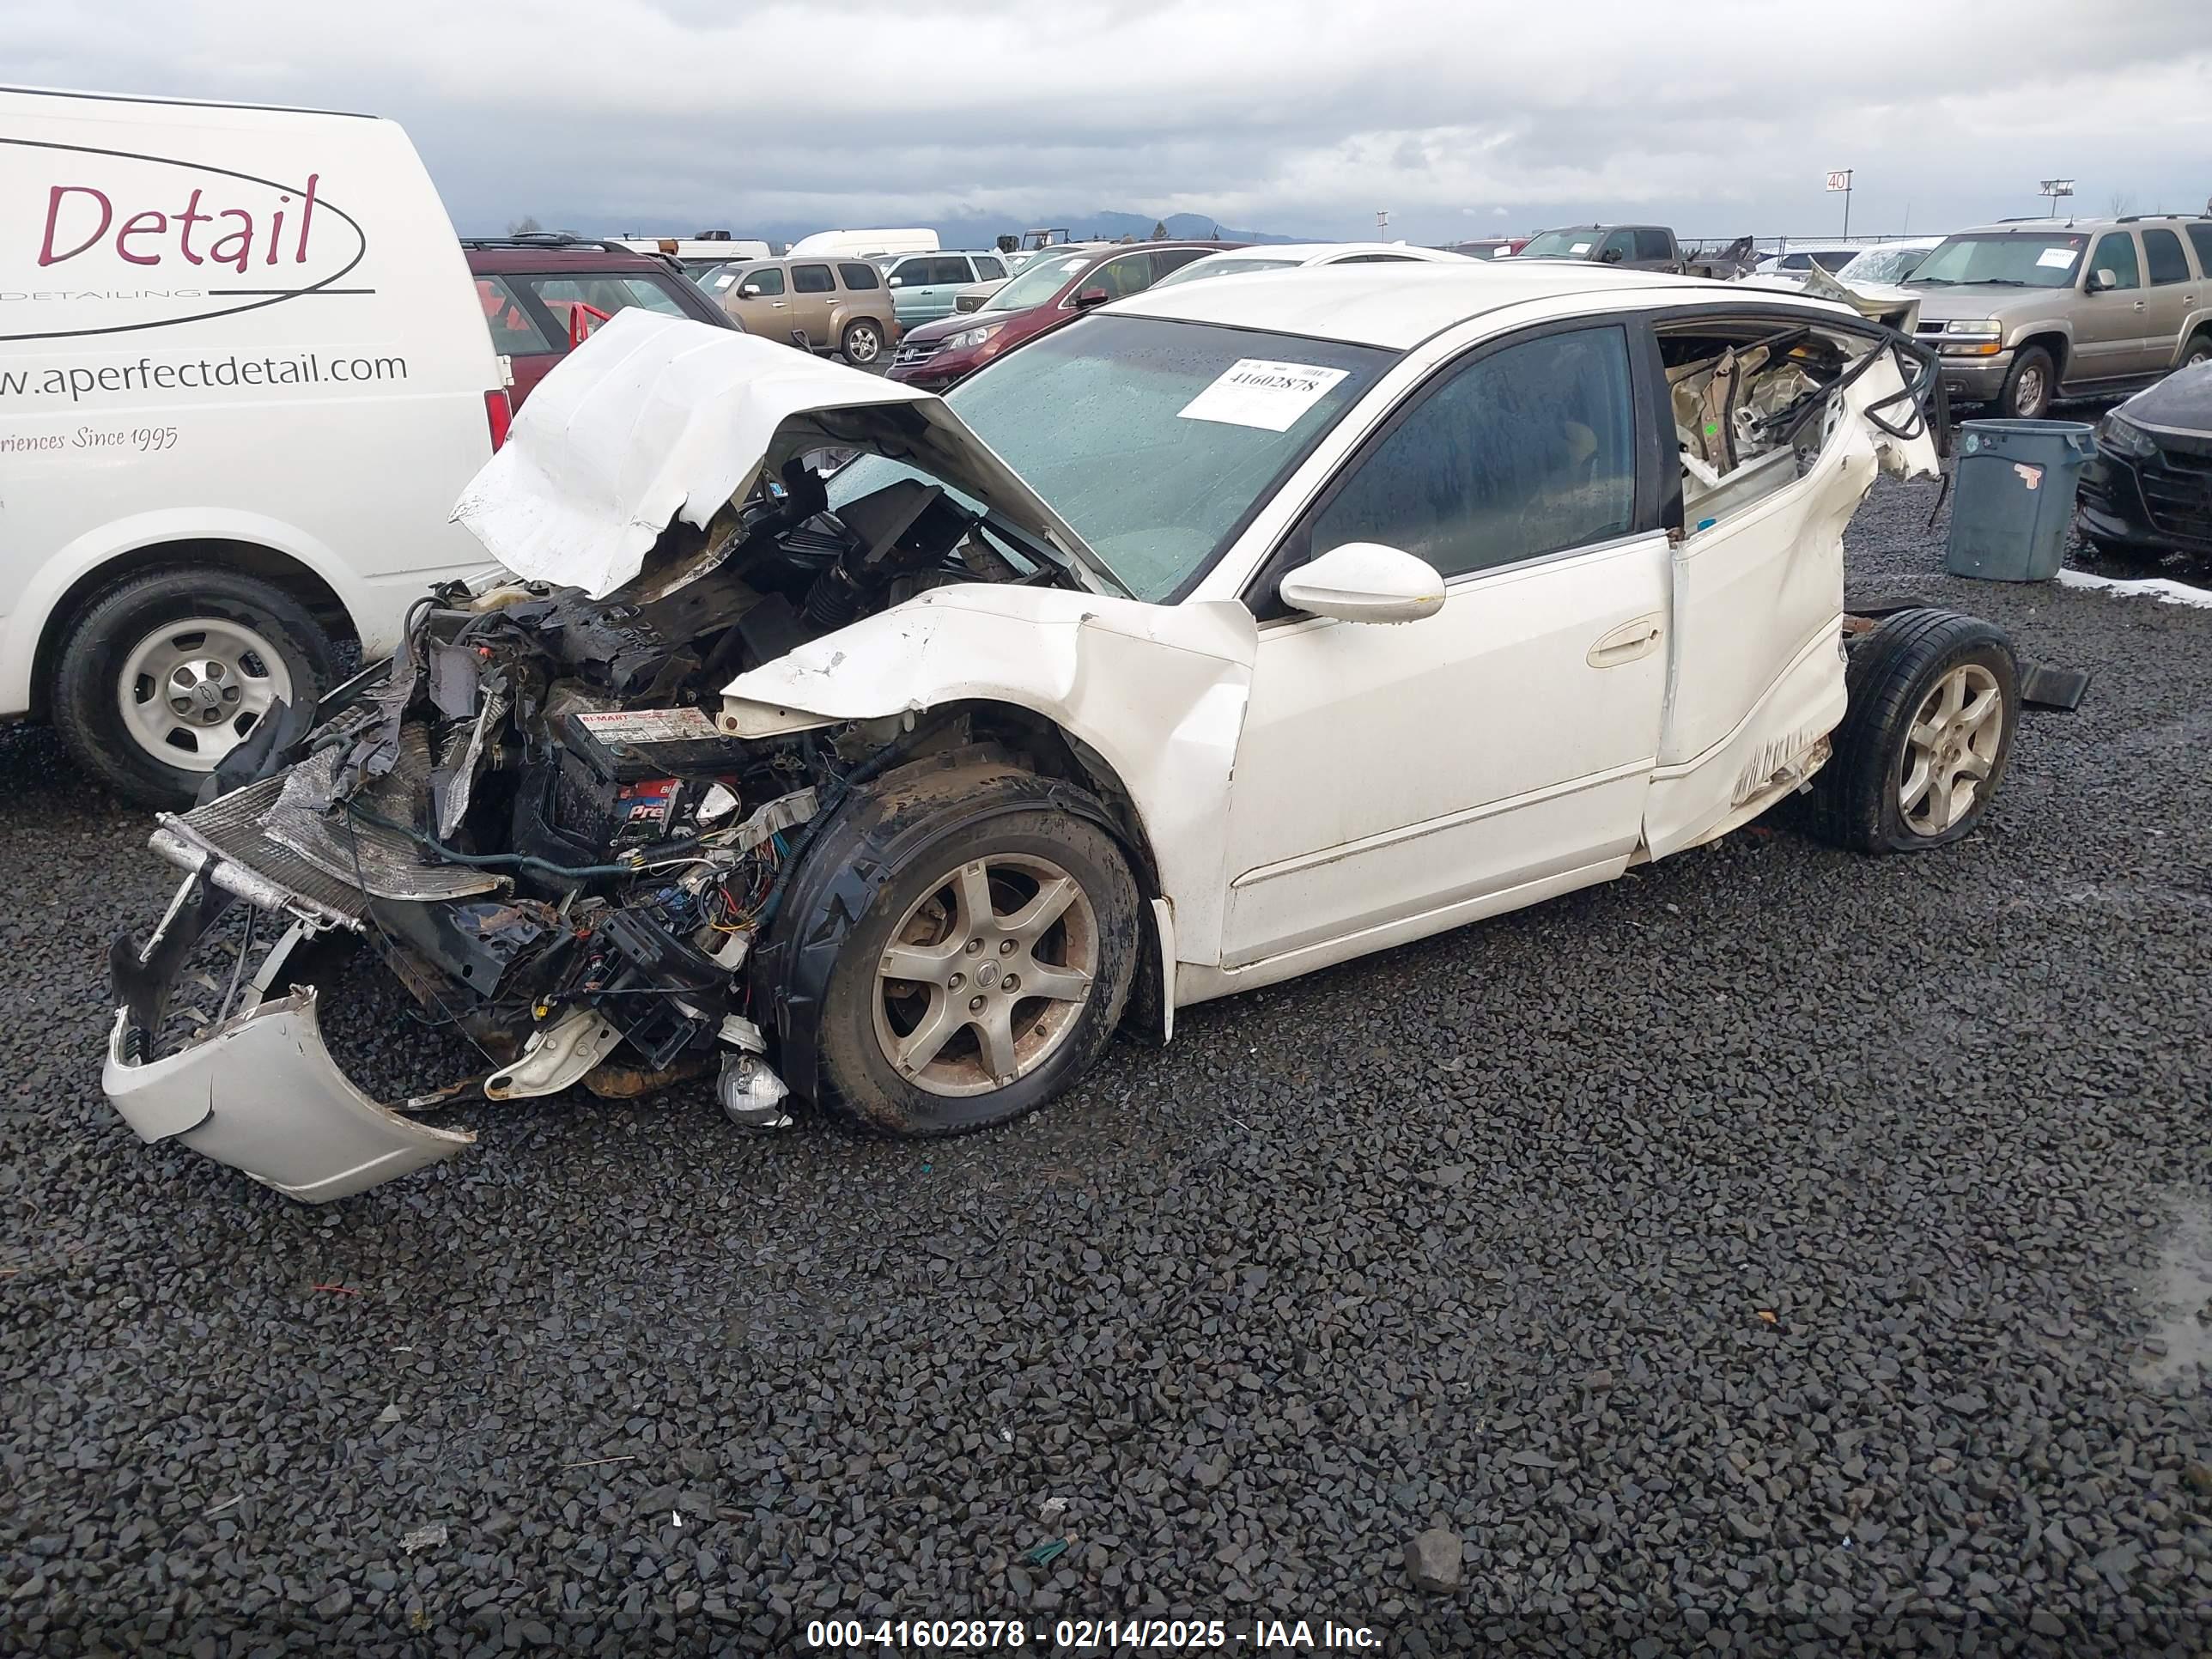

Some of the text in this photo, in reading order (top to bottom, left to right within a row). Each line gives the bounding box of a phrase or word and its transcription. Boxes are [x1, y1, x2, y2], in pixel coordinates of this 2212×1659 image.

[1828, 173, 1845, 189] 40
[38, 173, 319, 273] Detail
[0, 289, 202, 301] DETAILING
[1230, 372, 1320, 392] 41602878
[72, 426, 125, 447] Since
[131, 427, 179, 451] 1995
